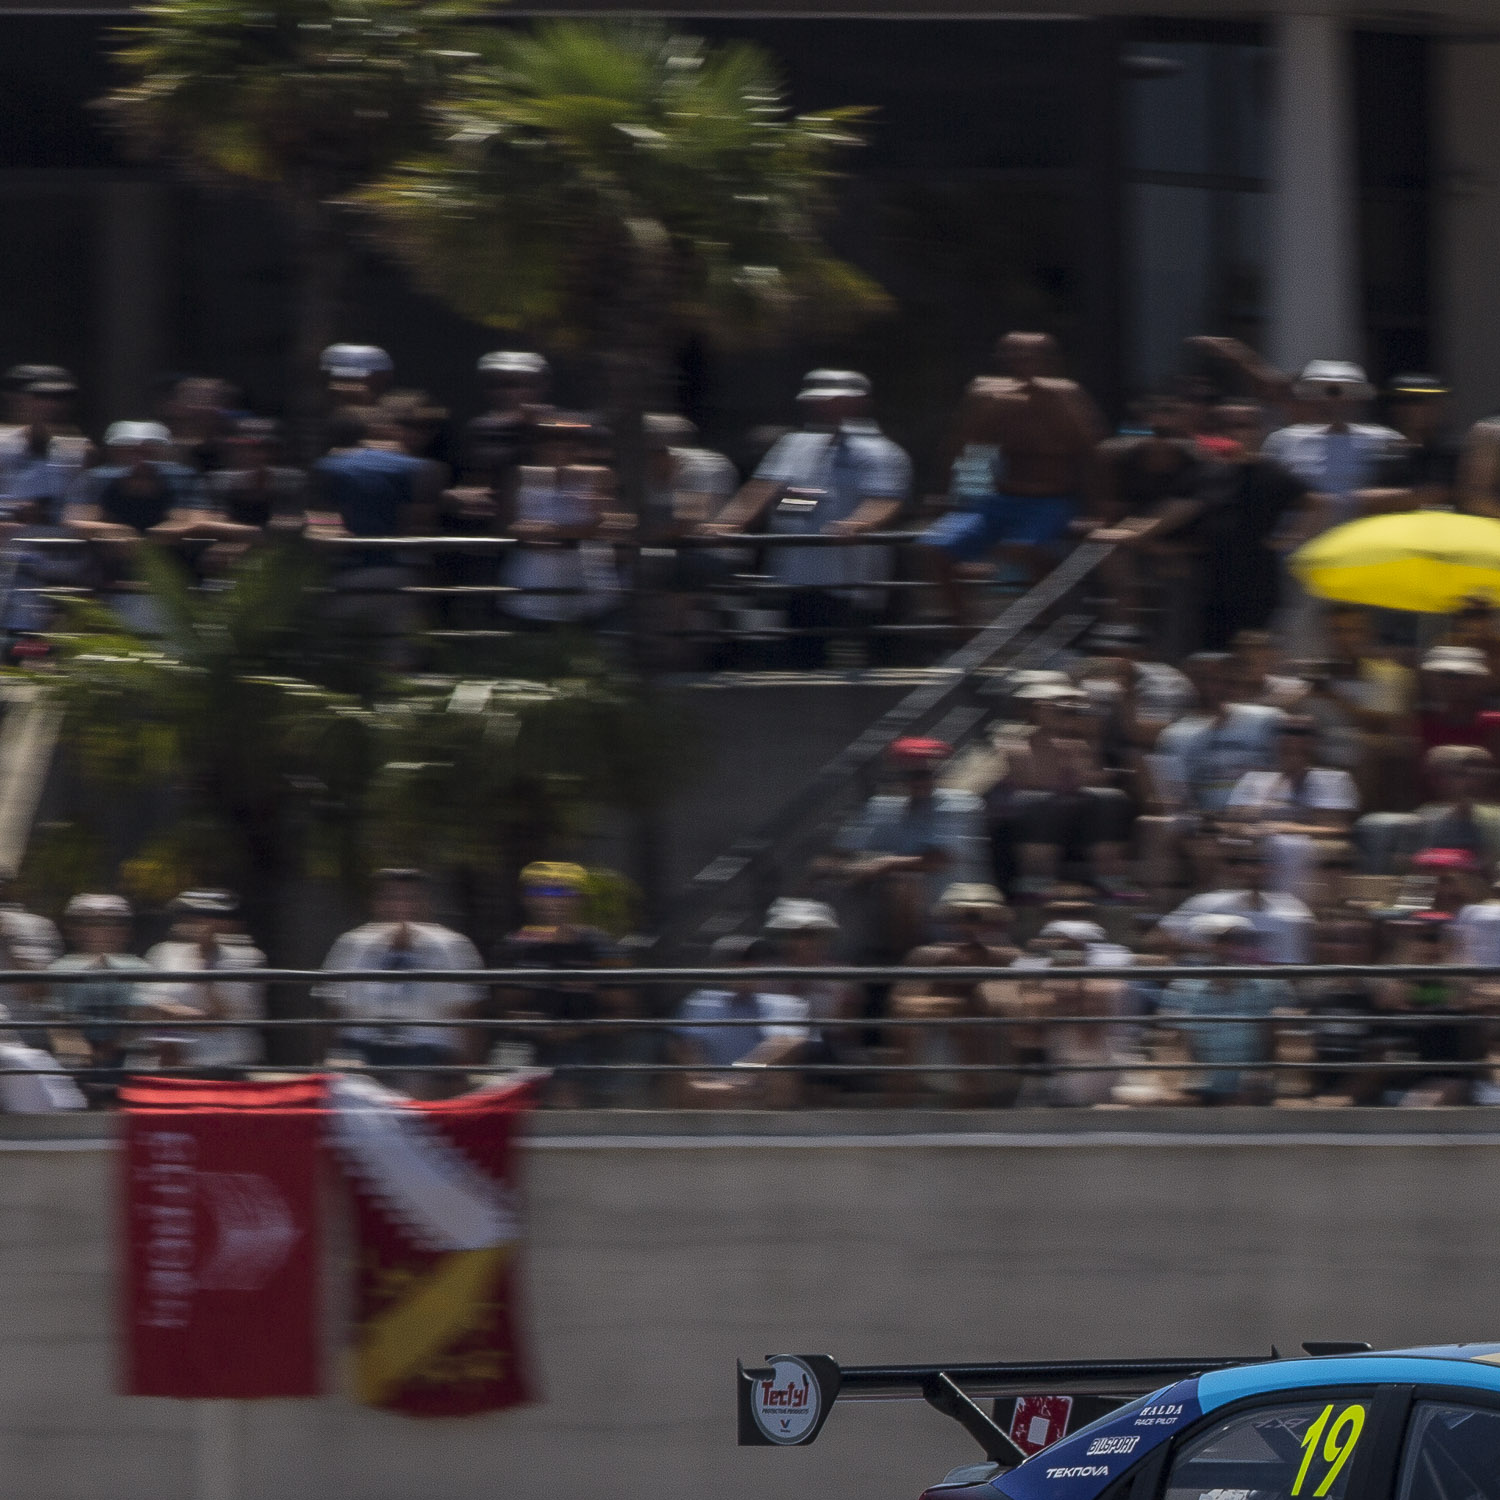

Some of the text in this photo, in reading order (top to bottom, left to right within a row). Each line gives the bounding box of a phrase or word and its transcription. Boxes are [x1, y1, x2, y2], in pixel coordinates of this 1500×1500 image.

[1140, 1404, 1184, 1417] HALDA
[1134, 1417, 1179, 1427] RACE PILOT
[1086, 1436, 1141, 1456] BILSPORT
[1290, 1404, 1366, 1498] 19
